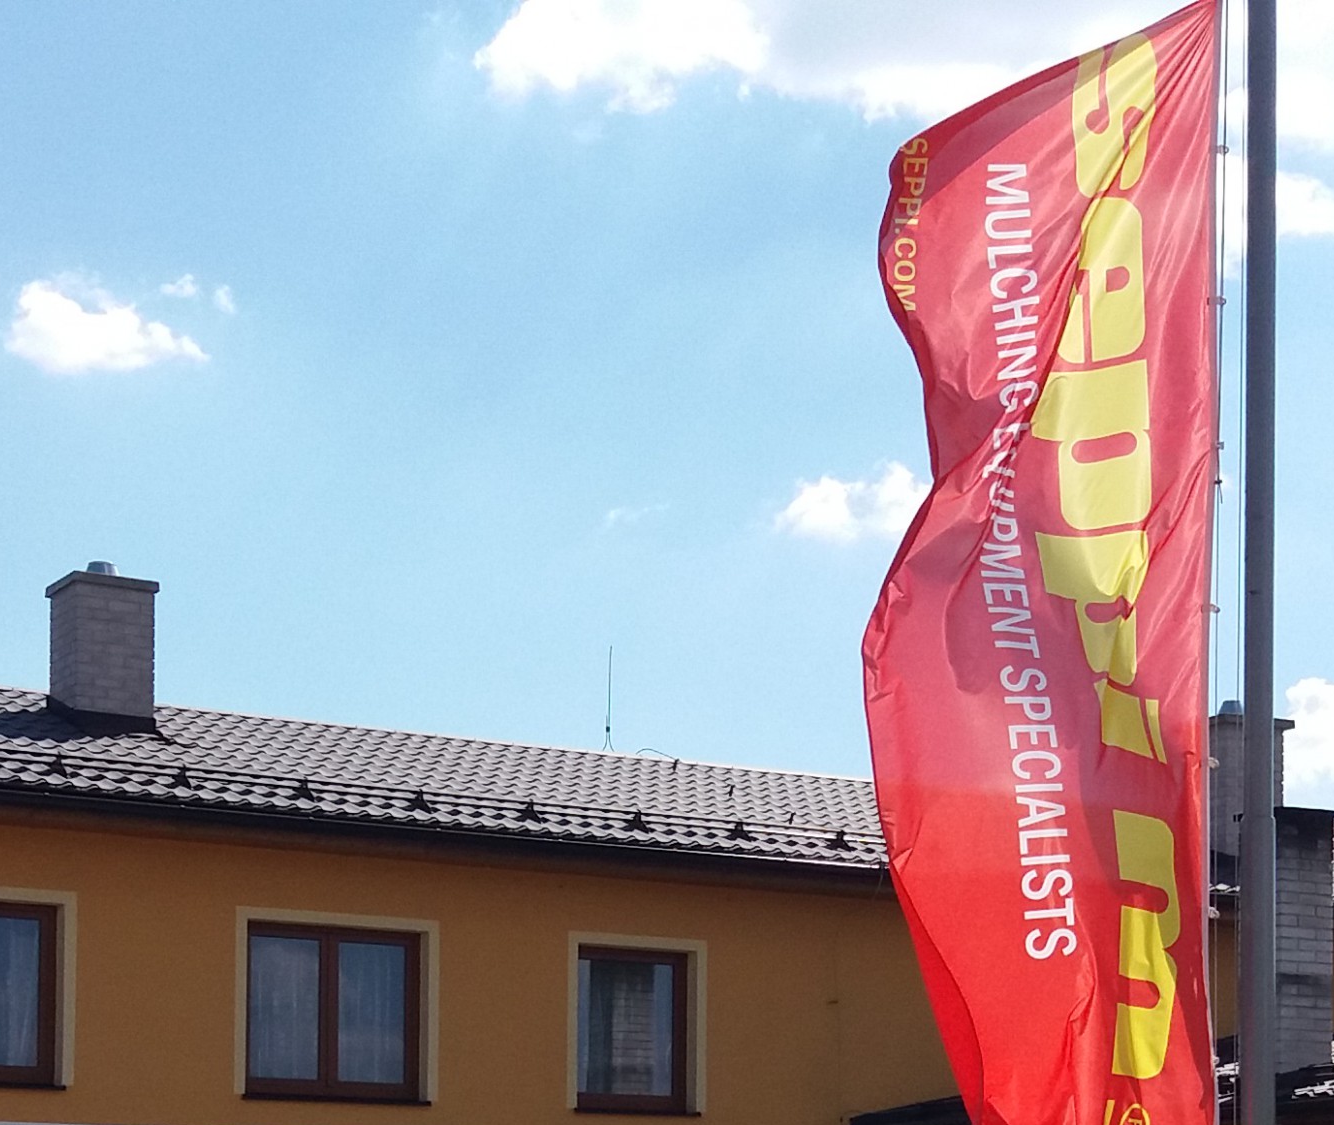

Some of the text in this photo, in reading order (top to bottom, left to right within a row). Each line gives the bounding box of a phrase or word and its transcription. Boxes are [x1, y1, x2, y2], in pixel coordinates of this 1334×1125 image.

[890, 136, 929, 312] SEPPI.COM
[985, 163, 1039, 413] MULCHING
[999, 664, 1078, 960] SPECIALISTS
